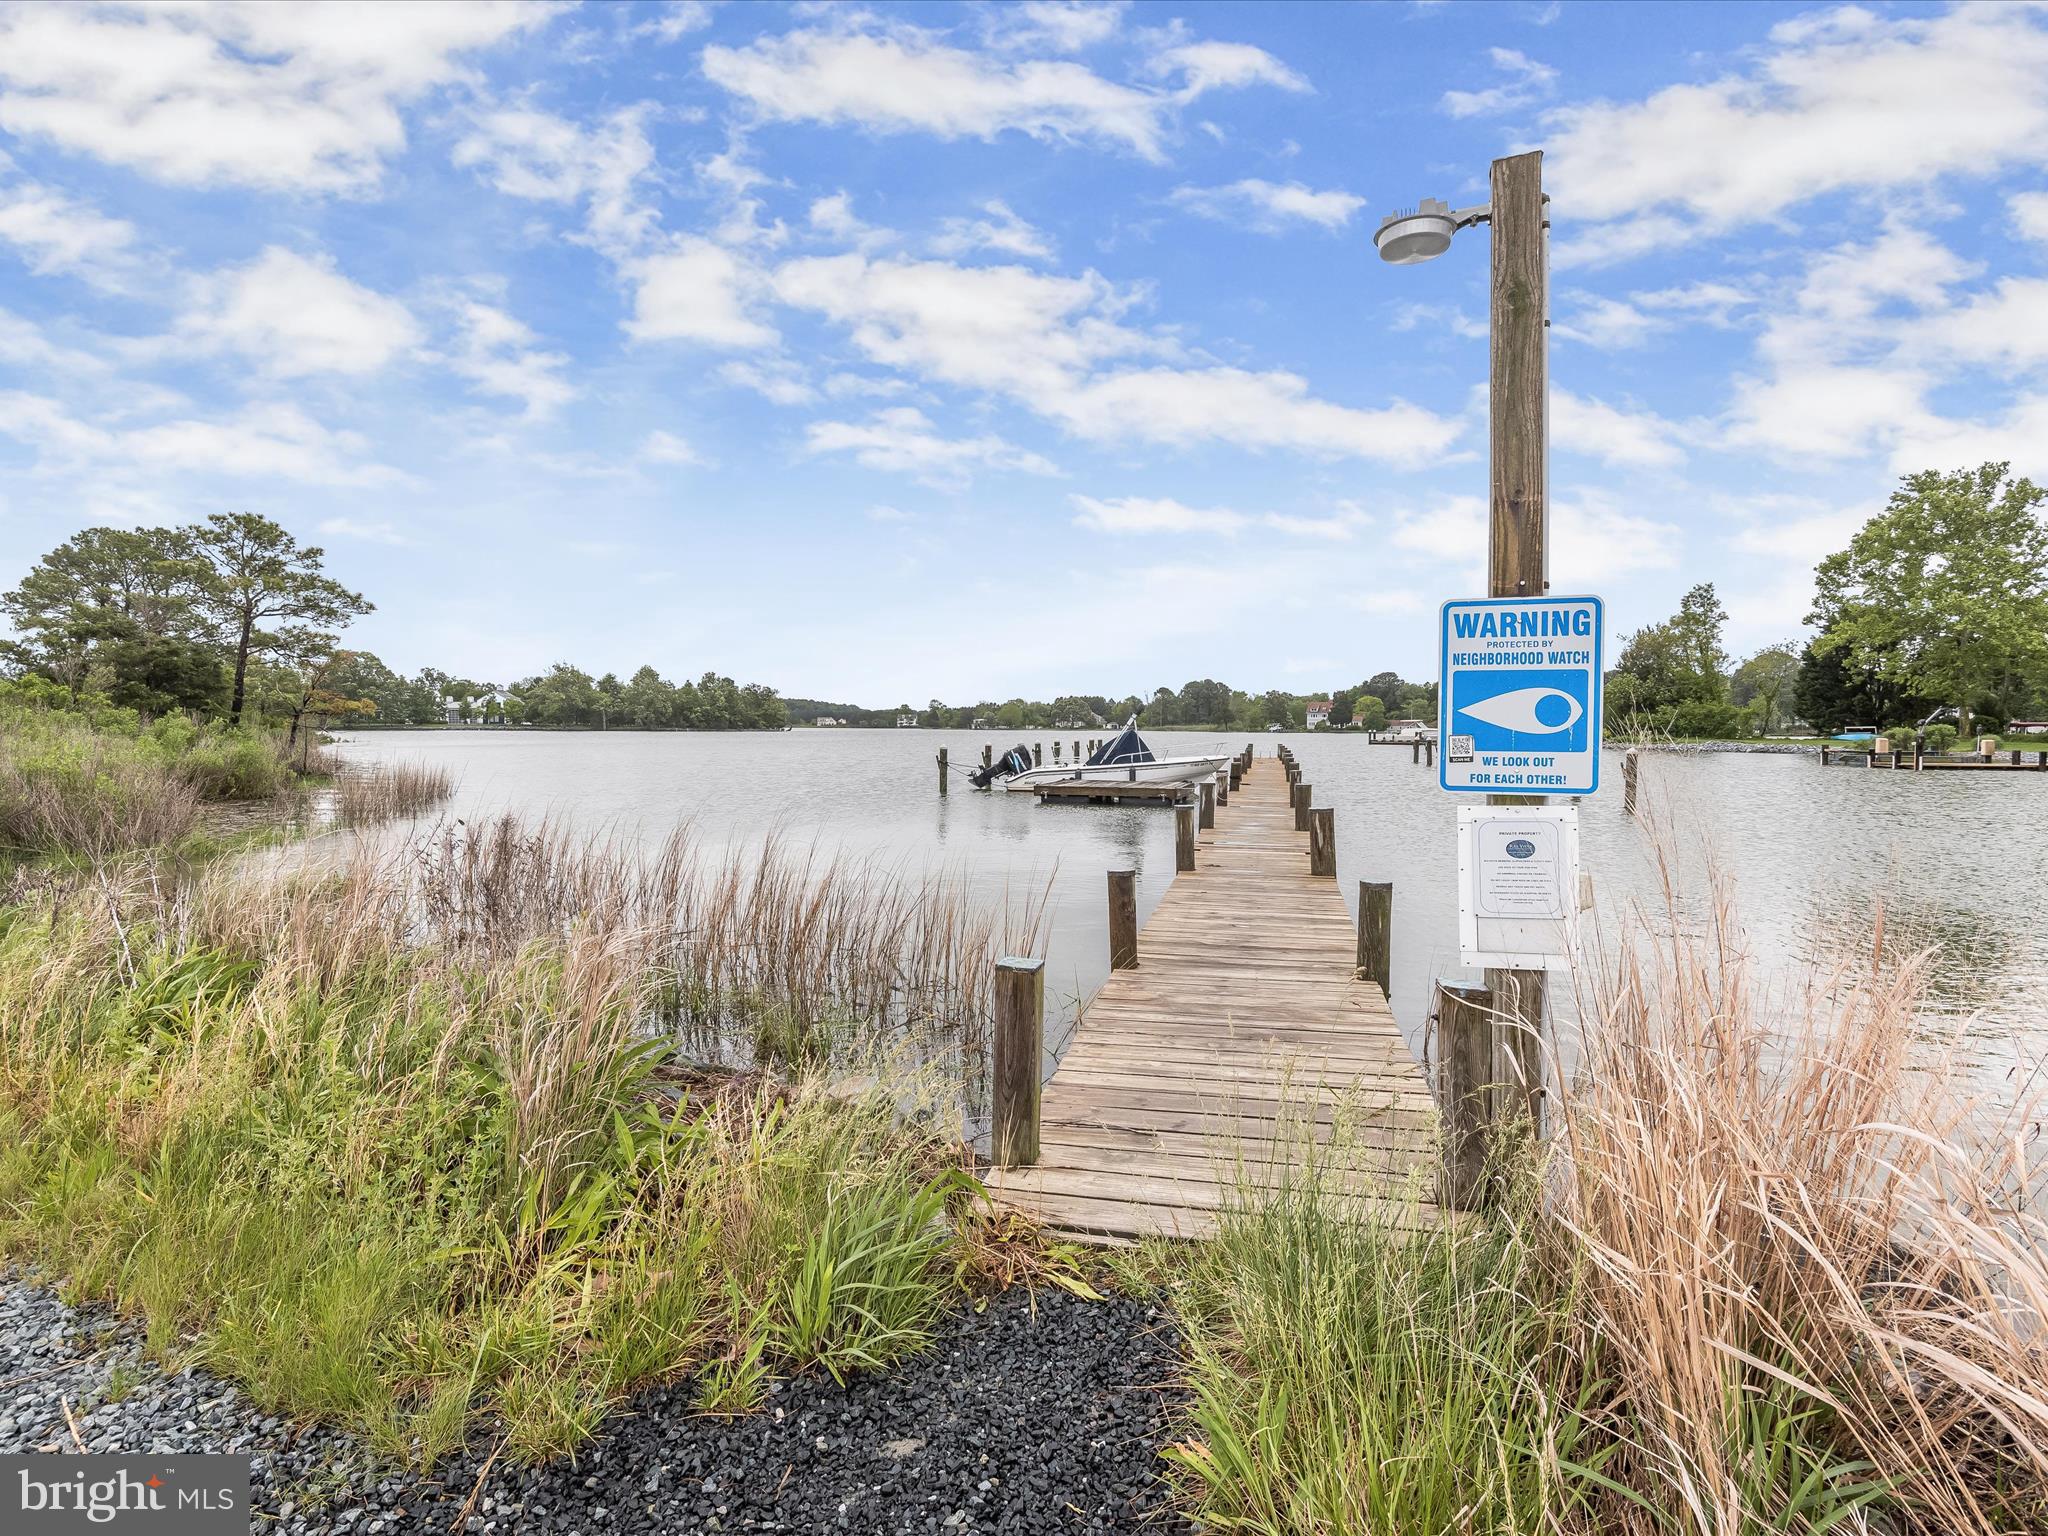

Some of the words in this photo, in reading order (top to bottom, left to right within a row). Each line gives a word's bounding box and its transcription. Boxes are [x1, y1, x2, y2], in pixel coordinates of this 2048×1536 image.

[1453, 609, 1591, 639] WARNING
[1486, 640, 1539, 649] PROTECTED
[1542, 640, 1554, 648] BY
[1452, 652, 1543, 666] NEIGHBORHOOD
[1548, 651, 1590, 665] WATCH
[1482, 756, 1498, 767] WE
[1502, 756, 1530, 767] LOOK
[1533, 757, 1555, 767] OUT
[1470, 773, 1490, 784] FOR
[1495, 774, 1523, 784] EACH
[1526, 774, 1567, 785] OTHER!
